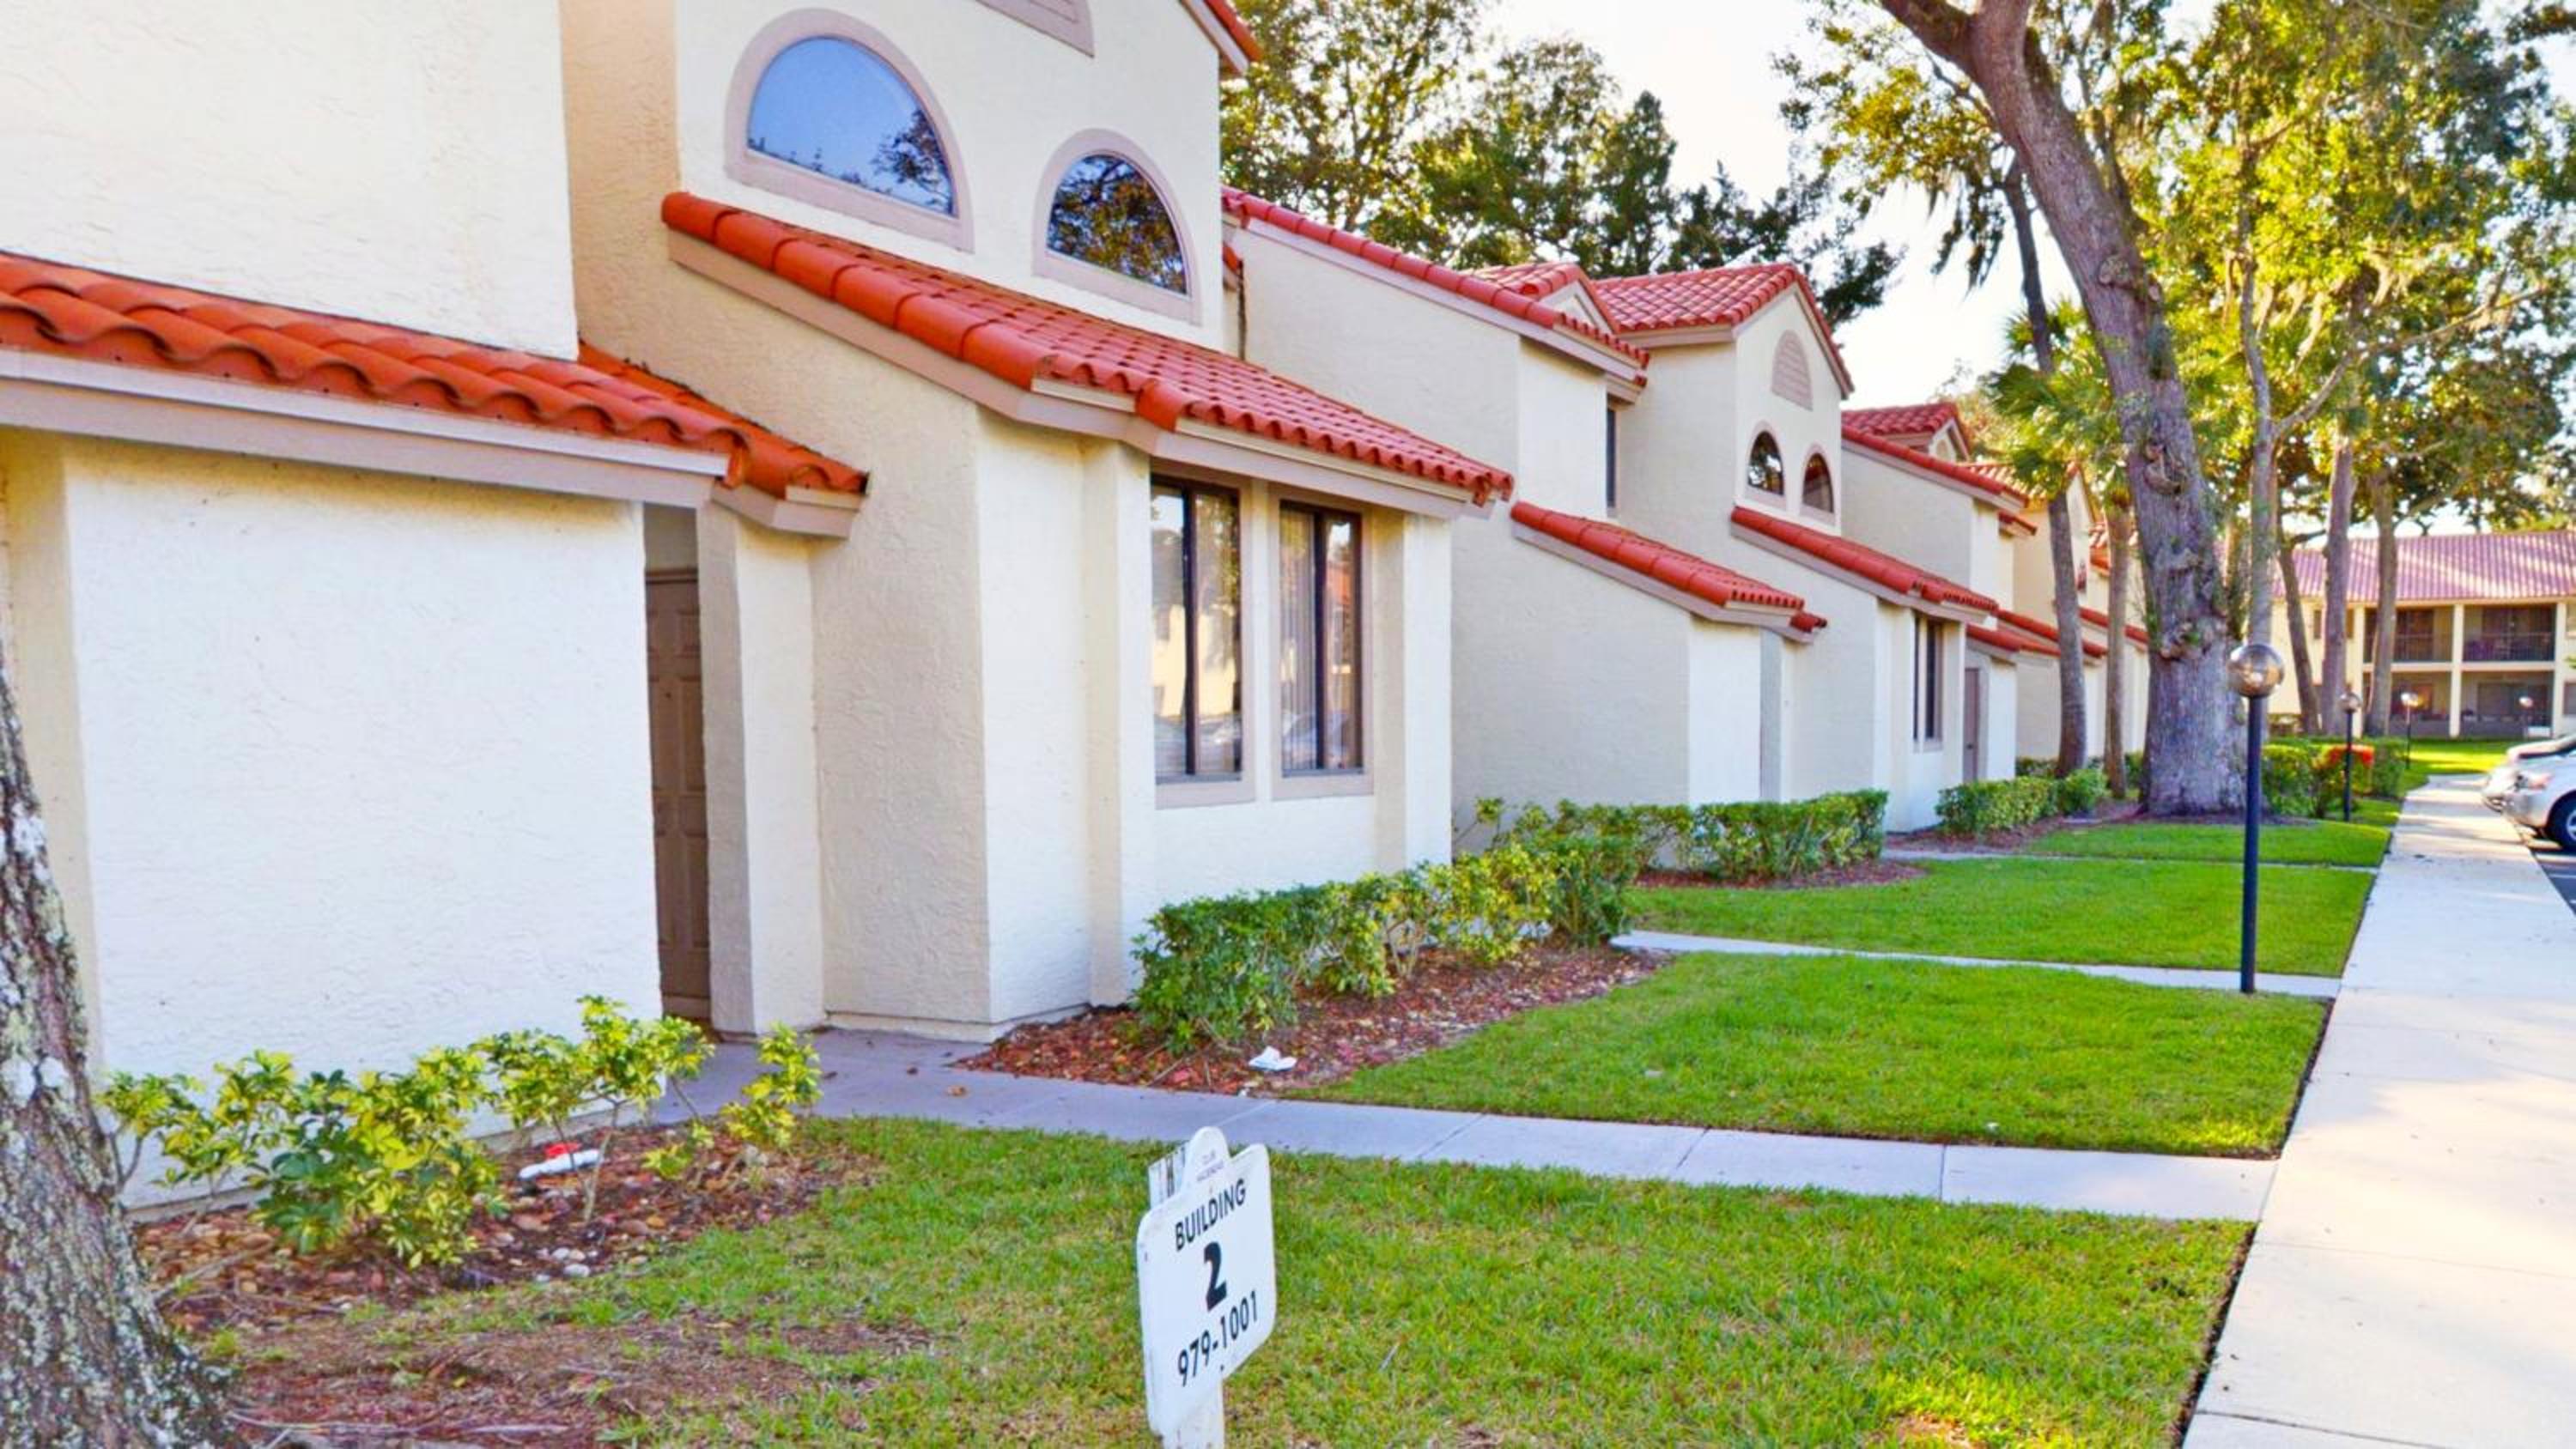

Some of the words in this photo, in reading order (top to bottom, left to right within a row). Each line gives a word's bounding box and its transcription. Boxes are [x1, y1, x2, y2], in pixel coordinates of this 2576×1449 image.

[1175, 1178, 1246, 1252] BUILDING
[1203, 1241, 1228, 1312] 2
[1176, 1290, 1258, 1388] 979-1001
